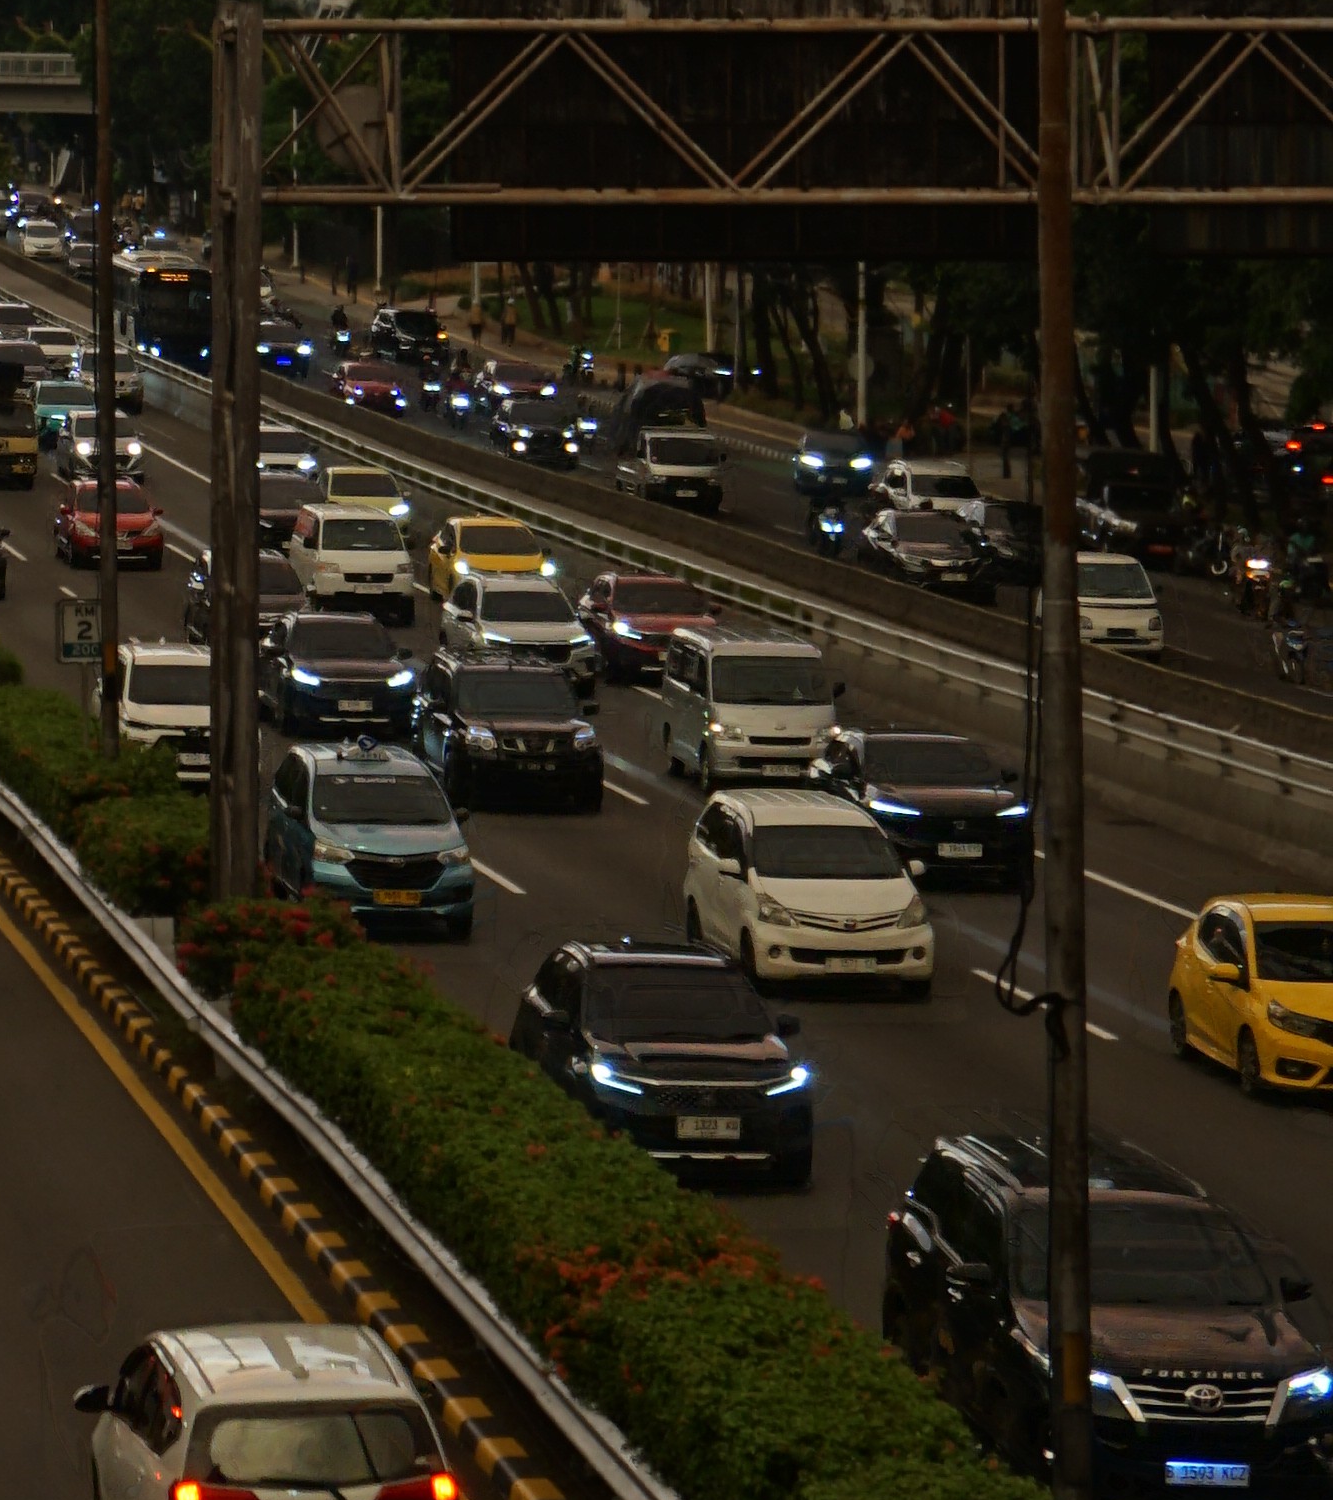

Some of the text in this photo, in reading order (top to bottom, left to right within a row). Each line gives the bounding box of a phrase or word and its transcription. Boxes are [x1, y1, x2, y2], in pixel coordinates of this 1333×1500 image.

[75, 606, 95, 617] KM
[77, 620, 93, 641] 2
[1142, 1368, 1265, 1380] FORTUNER
